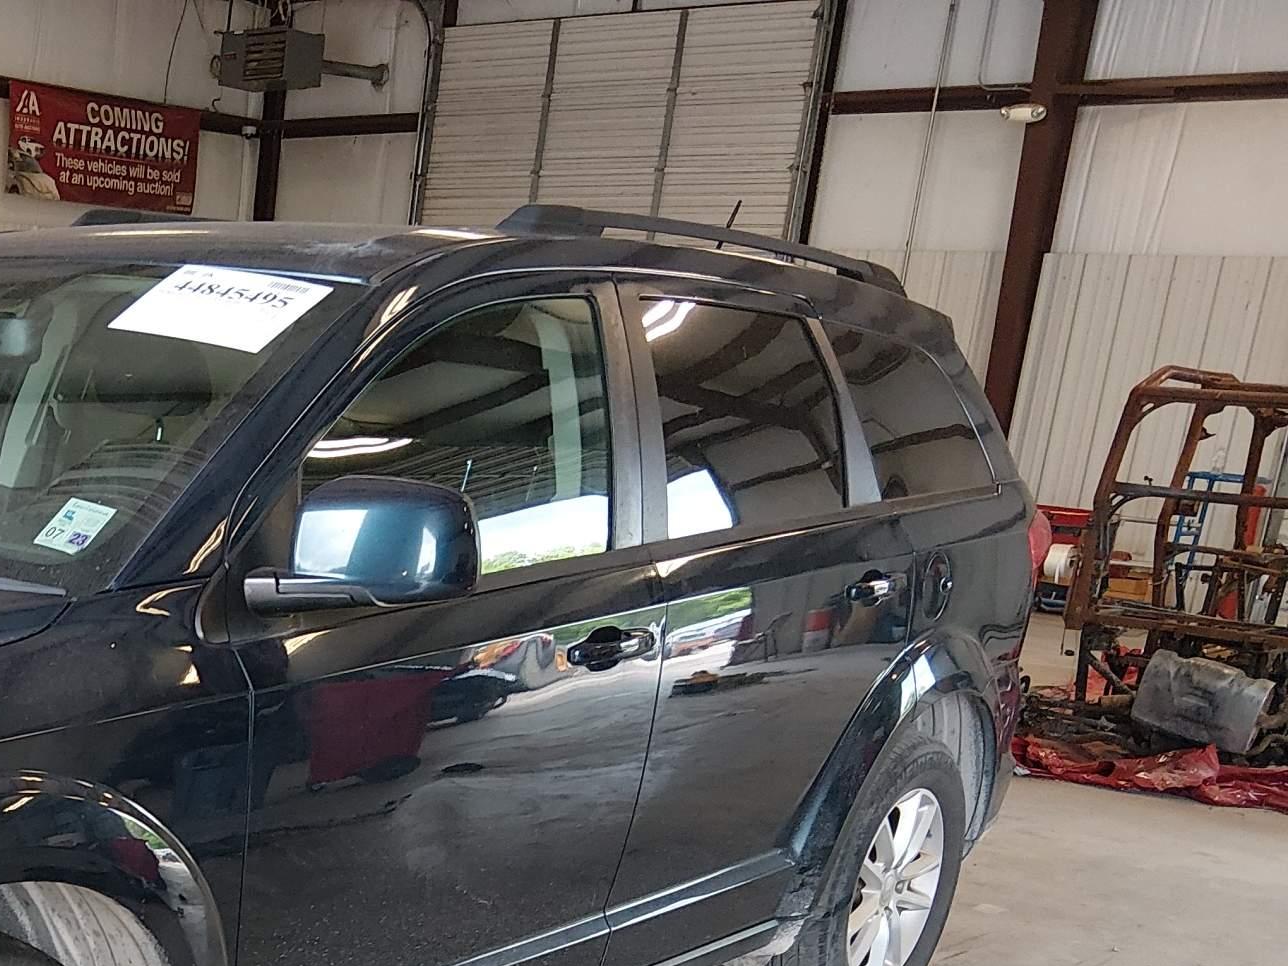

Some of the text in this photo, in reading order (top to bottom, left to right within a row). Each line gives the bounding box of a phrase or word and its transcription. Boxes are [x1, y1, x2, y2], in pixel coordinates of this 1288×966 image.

[86, 102, 164, 134] COMING
[52, 121, 190, 161] ATTRACTIONS!
[55, 153, 181, 183] These vehicles will be sold
[59, 170, 174, 197] at an upcoming auction!
[175, 280, 294, 308] 44845495
[45, 527, 88, 546] 07 23
